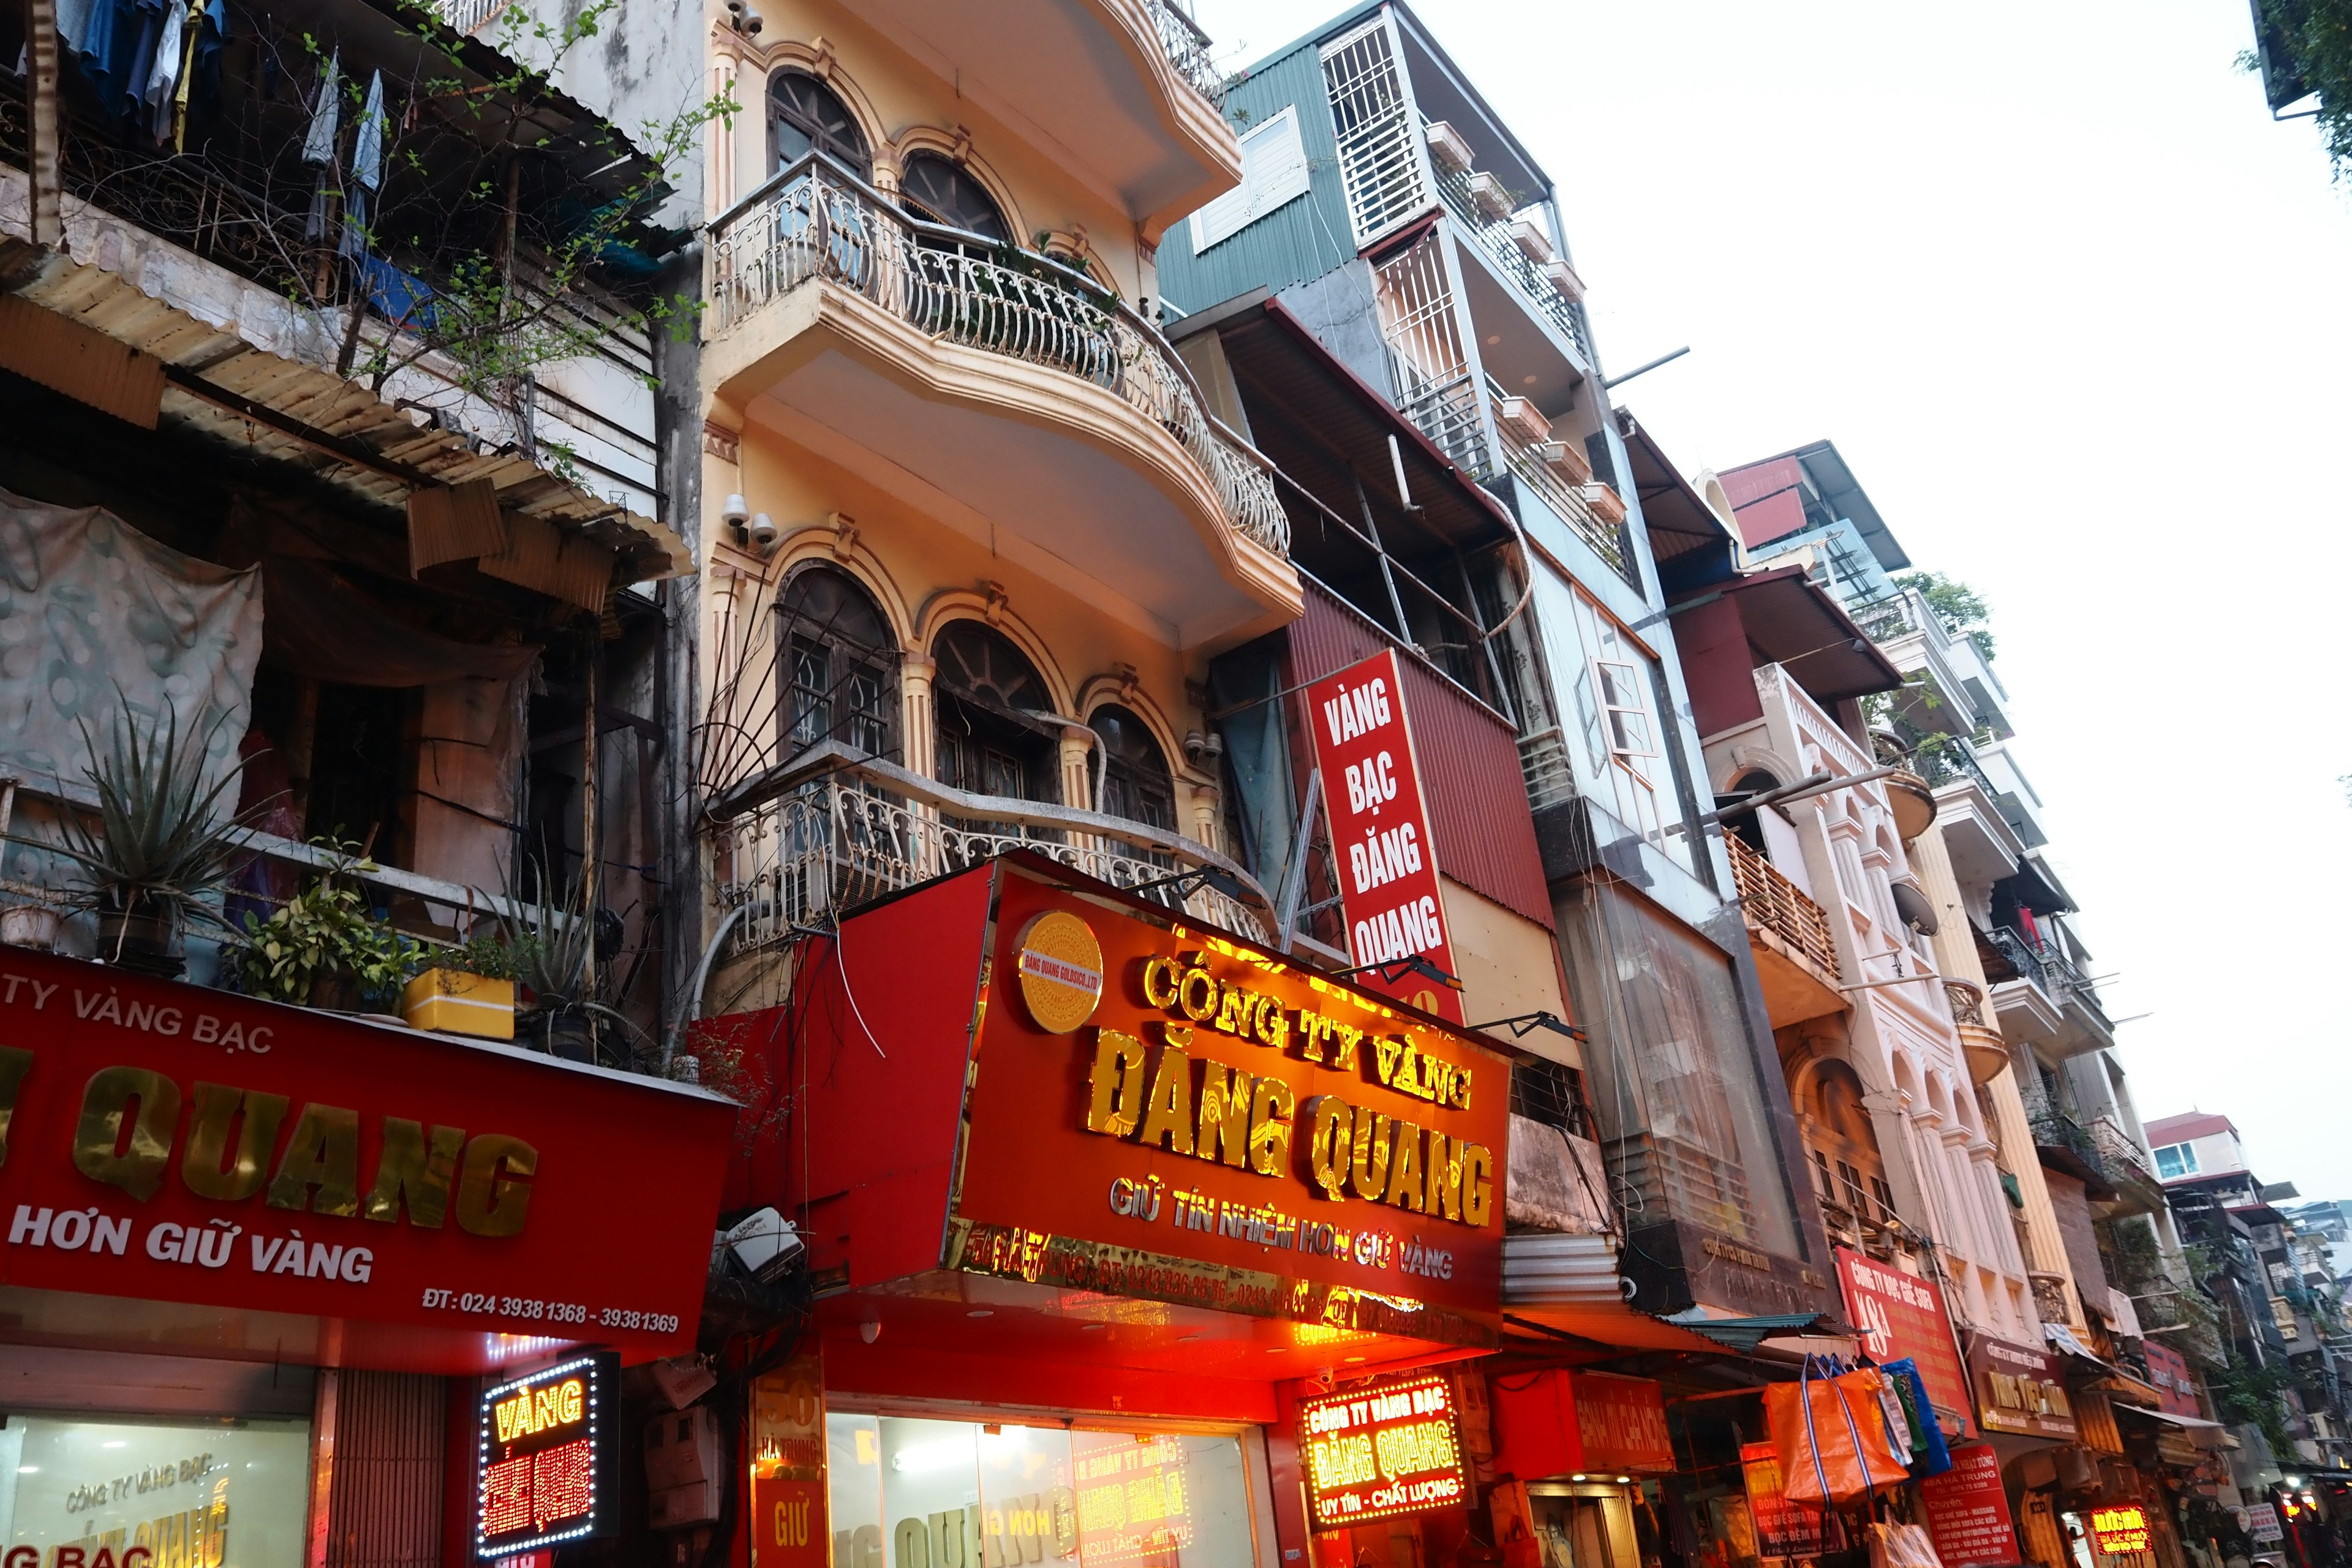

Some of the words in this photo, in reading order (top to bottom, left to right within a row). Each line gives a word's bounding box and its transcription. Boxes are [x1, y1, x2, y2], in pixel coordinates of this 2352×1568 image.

[1324, 677, 1391, 747] VÀNG
[1344, 751, 1396, 816] BẠC
[1349, 823, 1422, 894] ĐĂNG
[1355, 895, 1442, 975] QUANG
[1041, 960, 1059, 978] QUANG
[2, 973, 59, 1010] TY
[74, 987, 183, 1036] VÀNG
[192, 1014, 275, 1054] BẠC
[1143, 951, 1290, 1048] CÔNG
[1301, 1009, 1364, 1071] TY
[1371, 1032, 1472, 1110] VÀNG
[72, 1065, 539, 1237] QUANG
[1084, 1020, 1295, 1178] ĐĂNG
[1307, 1094, 1493, 1227] QUANG
[8, 1204, 132, 1256] HƠN
[146, 1218, 243, 1268] GIỮ
[251, 1229, 374, 1283] VÀNG
[1110, 1174, 1166, 1221] GIỮ
[1172, 1185, 1215, 1233] TÍN
[1218, 1202, 1297, 1254] NHIỆM
[1354, 1227, 1394, 1269] GIỮ
[1398, 1235, 1453, 1281] VÀNG
[460, 1292, 496, 1314] 024
[599, 1308, 679, 1333] 39381369
[1850, 1257, 1876, 1291] CÔNG
[1872, 1269, 1885, 1294] TY
[1883, 1273, 1902, 1303] BỌC
[1914, 1286, 1936, 1313] SOFA
[1854, 1289, 1893, 1357] 48A
[496, 1379, 582, 1442] VÀNG
[758, 1379, 815, 1427] 50
[1310, 1404, 1349, 1434] CÔNG
[1349, 1401, 1368, 1426] TY
[1370, 1393, 1412, 1423] VÀNG
[1412, 1385, 1446, 1417] BẠC
[761, 1433, 780, 1460] HÀ
[780, 1438, 816, 1461] TRUNG
[1313, 1430, 1376, 1490] ĐĂNG
[1376, 1420, 1455, 1482] QUANG
[1961, 1470, 1996, 1482] TRUNG
[66, 1483, 109, 1513] CÔNG
[111, 1474, 134, 1501] TY
[135, 1463, 175, 1494] VÀNG
[178, 1452, 213, 1485] BẠC
[1320, 1498, 1338, 1517] UY
[1338, 1491, 1362, 1513] TÍN
[1371, 1481, 1408, 1508] CHẤT
[1409, 1478, 1459, 1502] LƯỢNG
[774, 1491, 810, 1547] GIỮ
[1757, 1515, 1771, 1529] BỌC
[1788, 1512, 1806, 1525] SOFA
[1768, 1532, 1787, 1547] BỌC
[1789, 1527, 1811, 1544] ĐỆM
